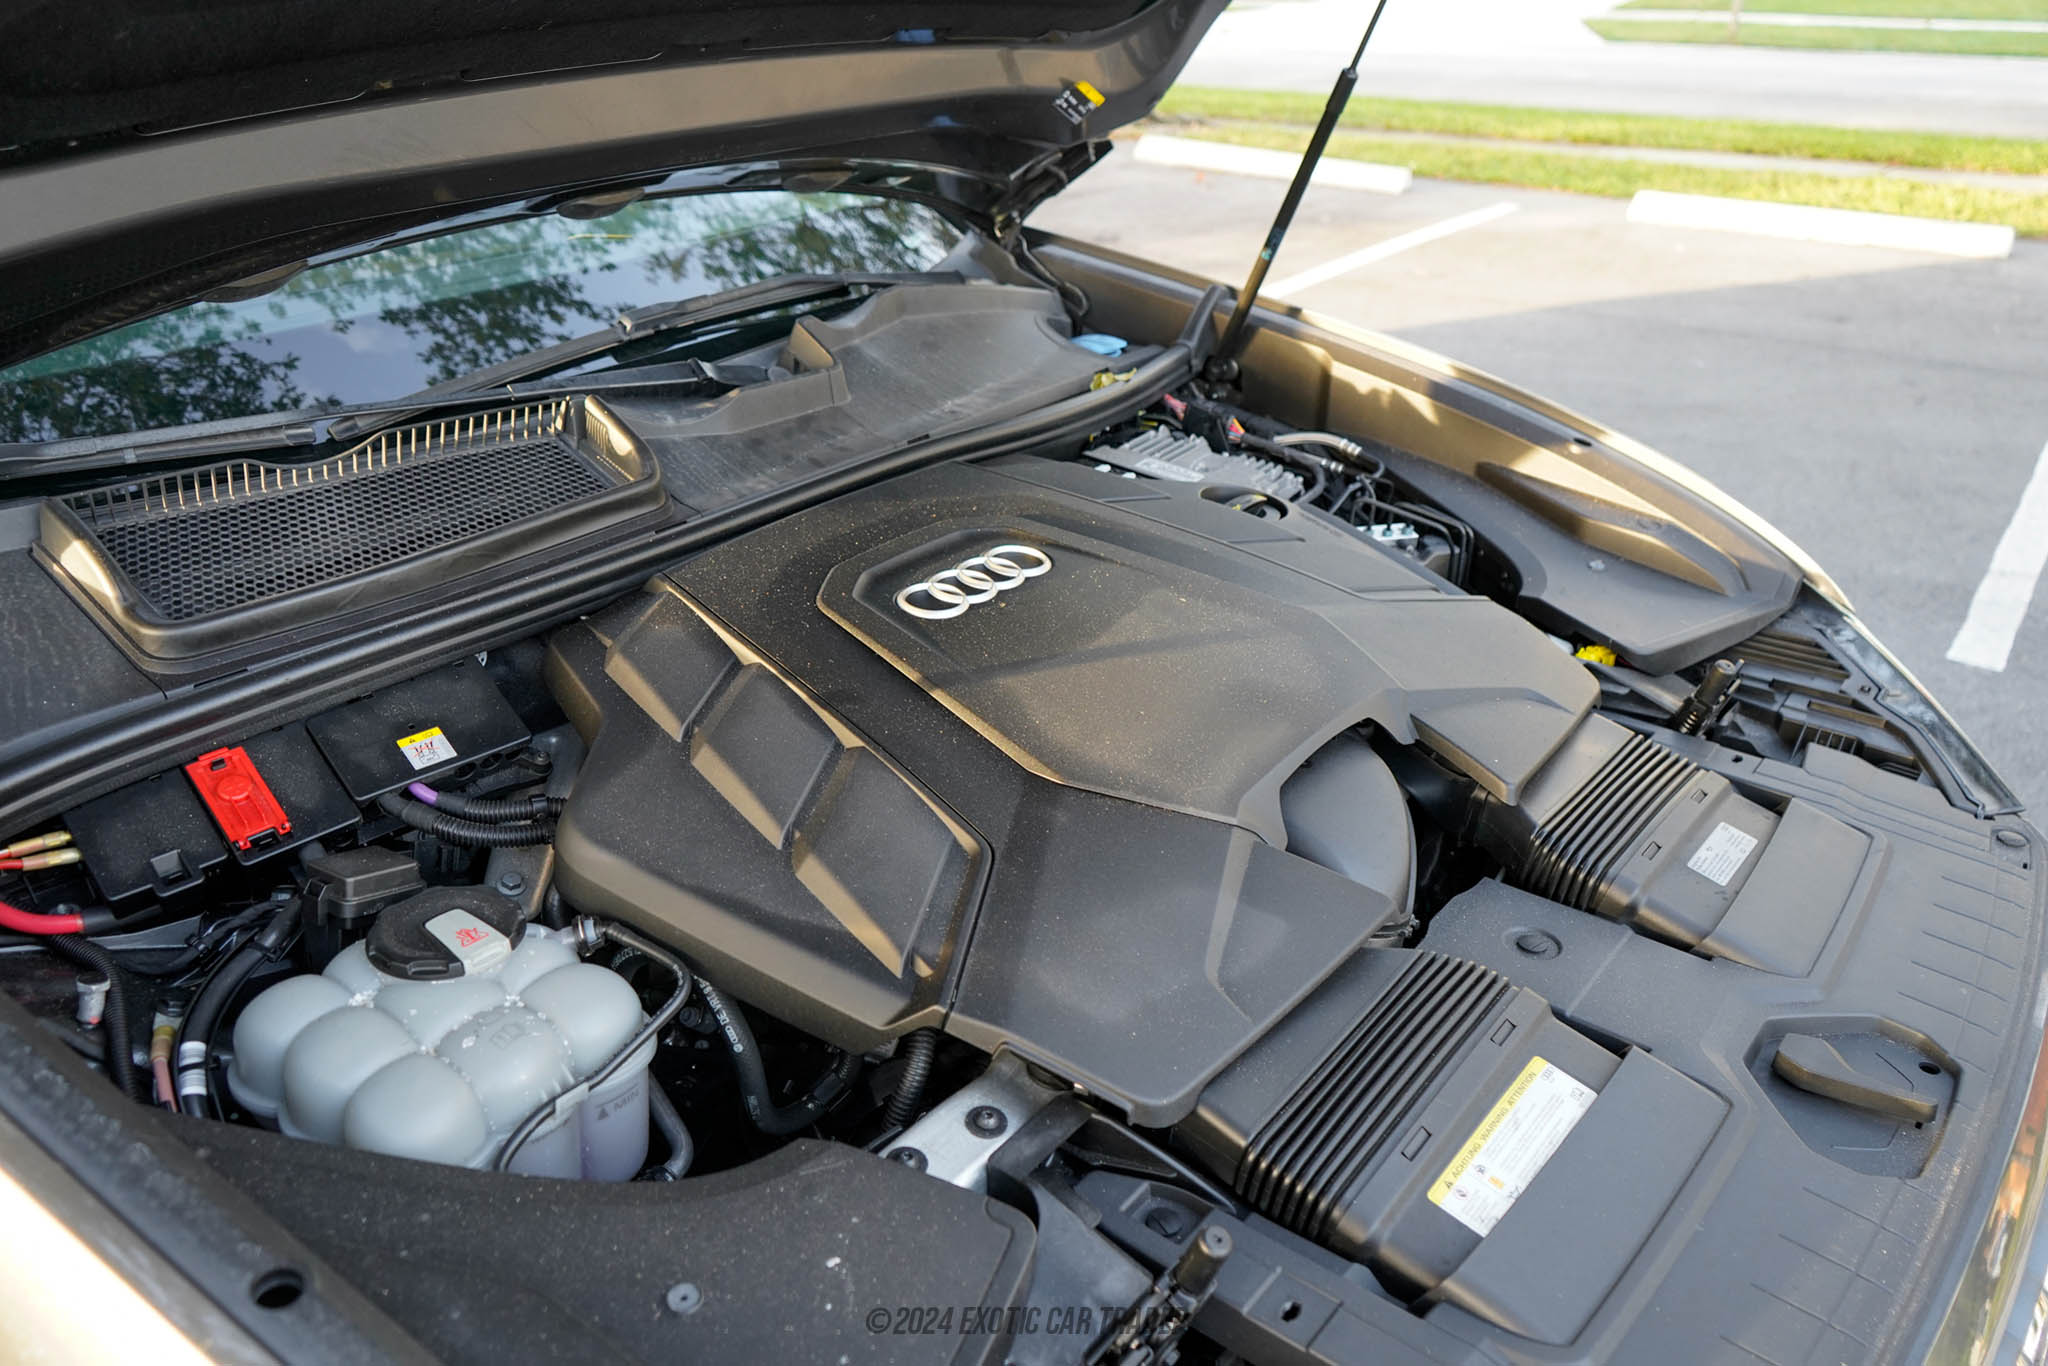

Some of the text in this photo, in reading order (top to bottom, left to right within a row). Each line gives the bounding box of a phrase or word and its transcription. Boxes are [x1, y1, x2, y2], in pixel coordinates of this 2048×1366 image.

[1452, 1071, 1537, 1178] ACHTUNG WARNING ATTENTION
